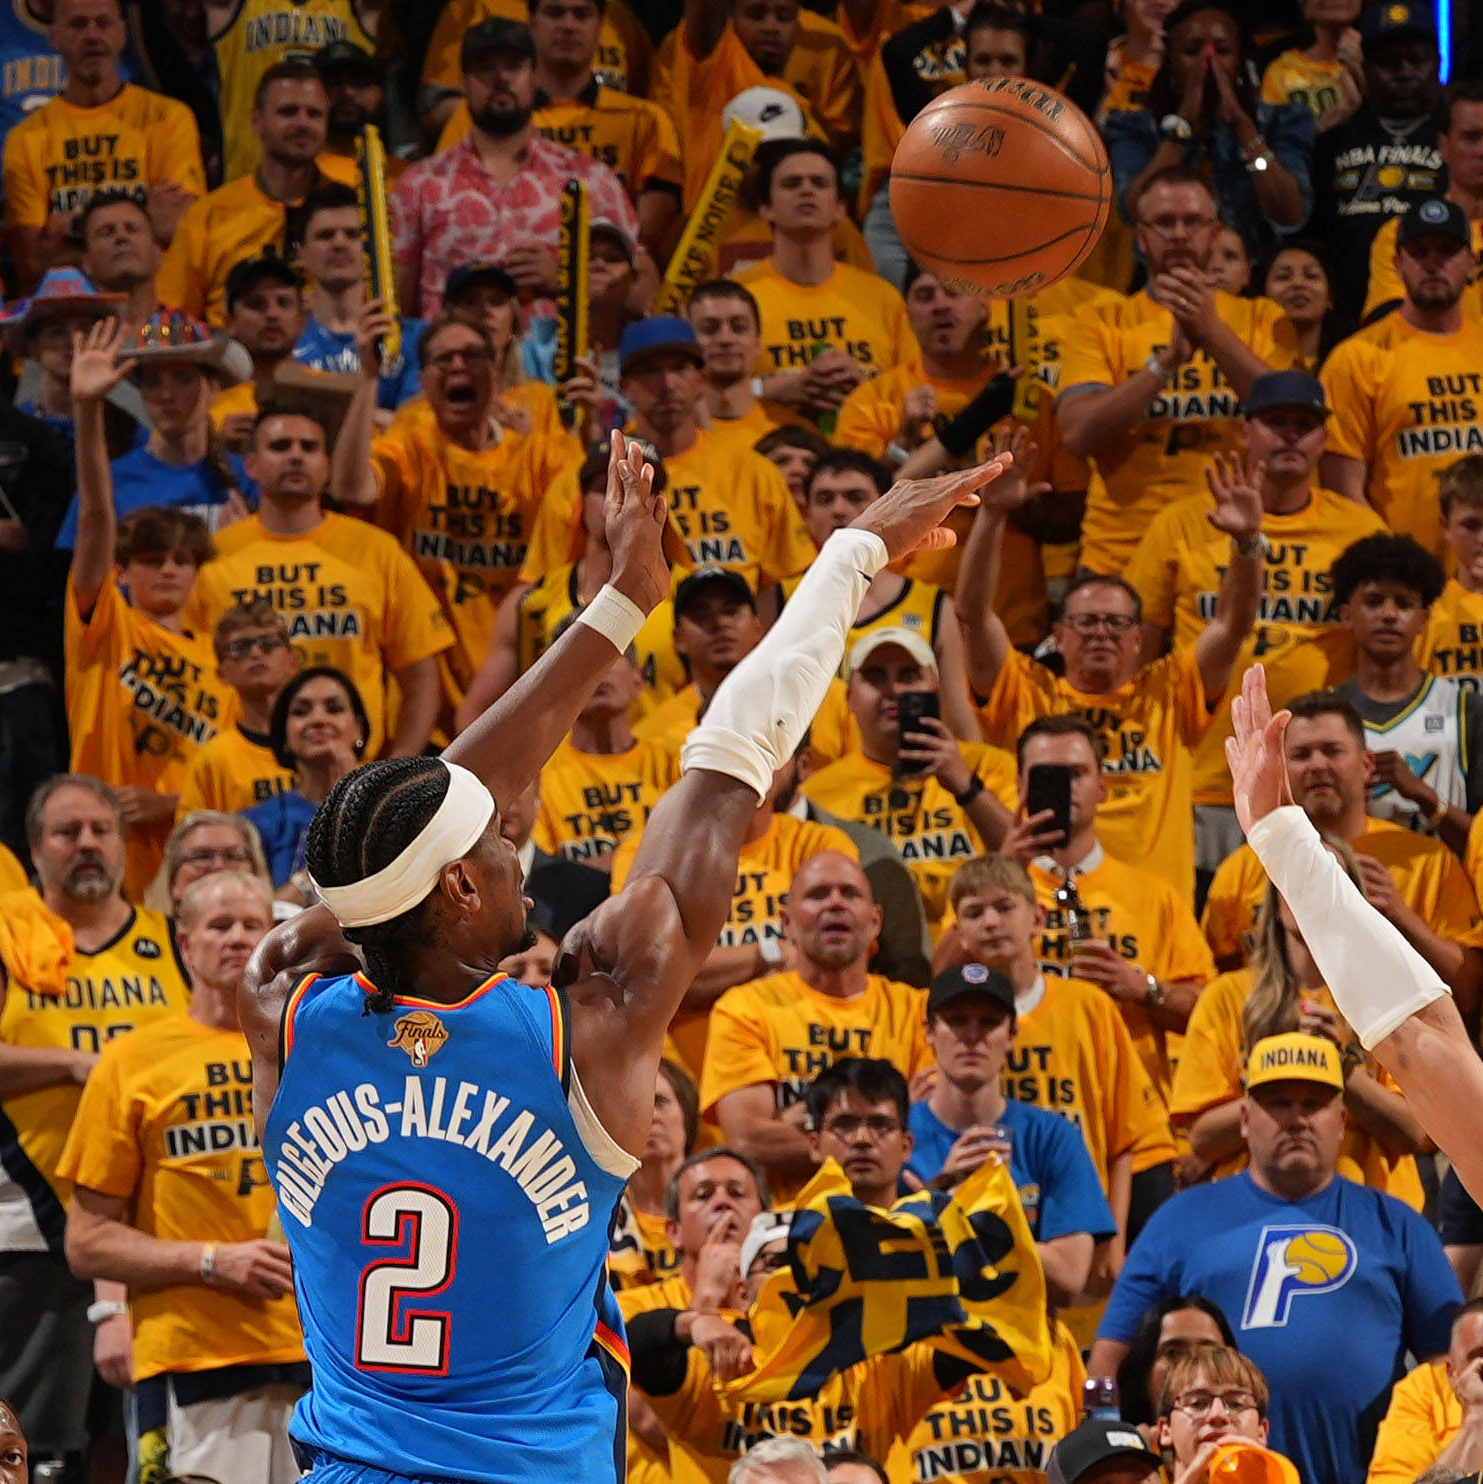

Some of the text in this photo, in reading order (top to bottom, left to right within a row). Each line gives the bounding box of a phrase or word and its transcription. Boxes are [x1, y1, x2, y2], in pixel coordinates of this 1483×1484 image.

[64, 135, 119, 158] BUT
[46, 159, 138, 181] THIS IS
[786, 319, 846, 340] BUT
[846, 342, 872, 364] IS
[1427, 374, 1482, 398] BUT
[1409, 399, 1478, 422] THIS
[446, 485, 501, 511] BUT
[497, 514, 523, 537] IS
[700, 511, 729, 534] IS
[255, 564, 320, 585] BUT
[1301, 568, 1334, 593] IS
[317, 584, 348, 607] IS
[582, 782, 643, 806] BUT
[564, 810, 631, 835] THIS
[922, 808, 952, 829] IS
[1113, 935, 1138, 958] IS
[388, 1017, 448, 1047] Finals
[808, 1024, 872, 1051] BUT
[1259, 1049, 1328, 1072] INDIANA
[207, 1063, 254, 1085] BU
[1048, 1075, 1075, 1100] IS
[278, 1074, 592, 1246] GILGEOUS-ALEXANDER
[356, 1181, 459, 1377] 2
[953, 1377, 1002, 1405] BU
[822, 1402, 853, 1430] IS
[926, 1406, 1054, 1437] THIS IS
